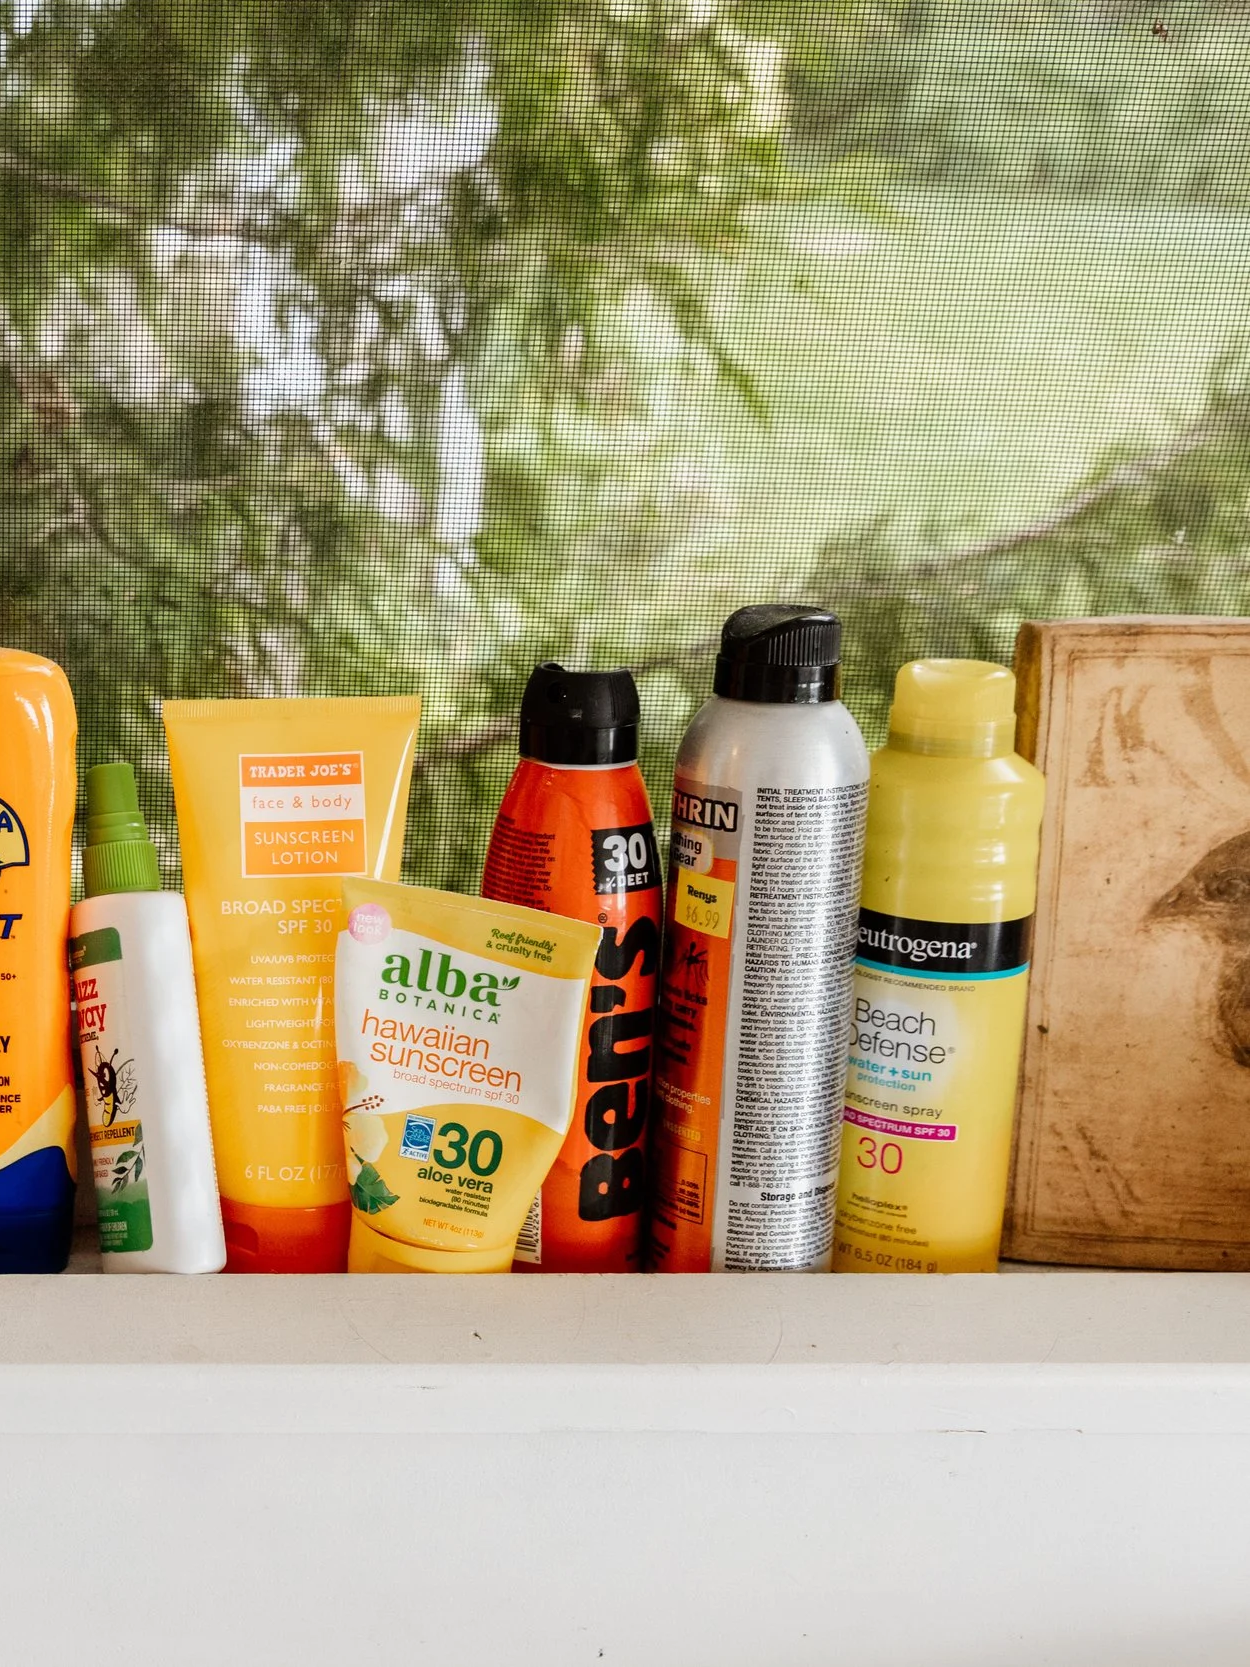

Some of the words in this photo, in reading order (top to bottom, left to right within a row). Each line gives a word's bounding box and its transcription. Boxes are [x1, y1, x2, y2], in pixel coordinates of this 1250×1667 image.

[250, 765, 306, 778] TRADER
[309, 764, 352, 777] JOE'S
[784, 788, 824, 796] TREATMENT
[252, 796, 284, 810] face
[292, 796, 303, 808] &
[312, 794, 352, 810] body
[254, 830, 354, 846] SUNSCREEN
[272, 852, 338, 865] LOTION
[602, 832, 646, 872] 30
[687, 884, 718, 904] Renys
[750, 892, 802, 900] RETREATMENT
[222, 900, 286, 915] BROAD
[278, 920, 308, 934] SPF
[314, 919, 332, 934] 30
[686, 906, 720, 930] $6.99
[354, 923, 382, 936] look
[492, 928, 516, 942] Reef
[486, 940, 492, 948] &
[495, 942, 532, 958] cruelty
[533, 949, 552, 962] free
[745, 958, 778, 966] HAZARDS
[0, 972, 16, 981] 50+
[382, 949, 502, 1007] alba
[228, 998, 278, 1008] ENRICHED
[280, 998, 309, 1006] WITH
[378, 988, 499, 1024] BOTANICA
[856, 998, 936, 1036] Beach
[362, 1008, 490, 1060] hawaiian
[370, 1042, 522, 1093] sunscreen
[578, 916, 658, 1221] Ben's
[392, 1068, 427, 1085] broad
[428, 1076, 482, 1098] spectrum
[484, 1088, 504, 1102] spf
[505, 1092, 520, 1106] 30
[857, 1072, 916, 1092] protection
[670, 1085, 711, 1106] properties
[902, 1104, 942, 1120] spray
[104, 1126, 135, 1140] REPELLENT
[856, 1114, 912, 1134] SPECTRUM
[914, 1126, 935, 1136] SPF
[937, 1128, 950, 1137] 30
[433, 1122, 503, 1176] 30
[857, 1136, 903, 1175] 30
[245, 1165, 252, 1179] 6
[258, 1166, 274, 1180] FL
[279, 1166, 305, 1180] OZ
[417, 1166, 454, 1184] aloe
[458, 1176, 494, 1194] vera
[445, 1188, 464, 1196] water
[464, 1191, 491, 1202] resistant
[760, 1192, 796, 1202] Storage
[798, 1190, 812, 1199] and
[418, 1196, 464, 1212] biodegradable
[464, 1208, 488, 1218] formula
